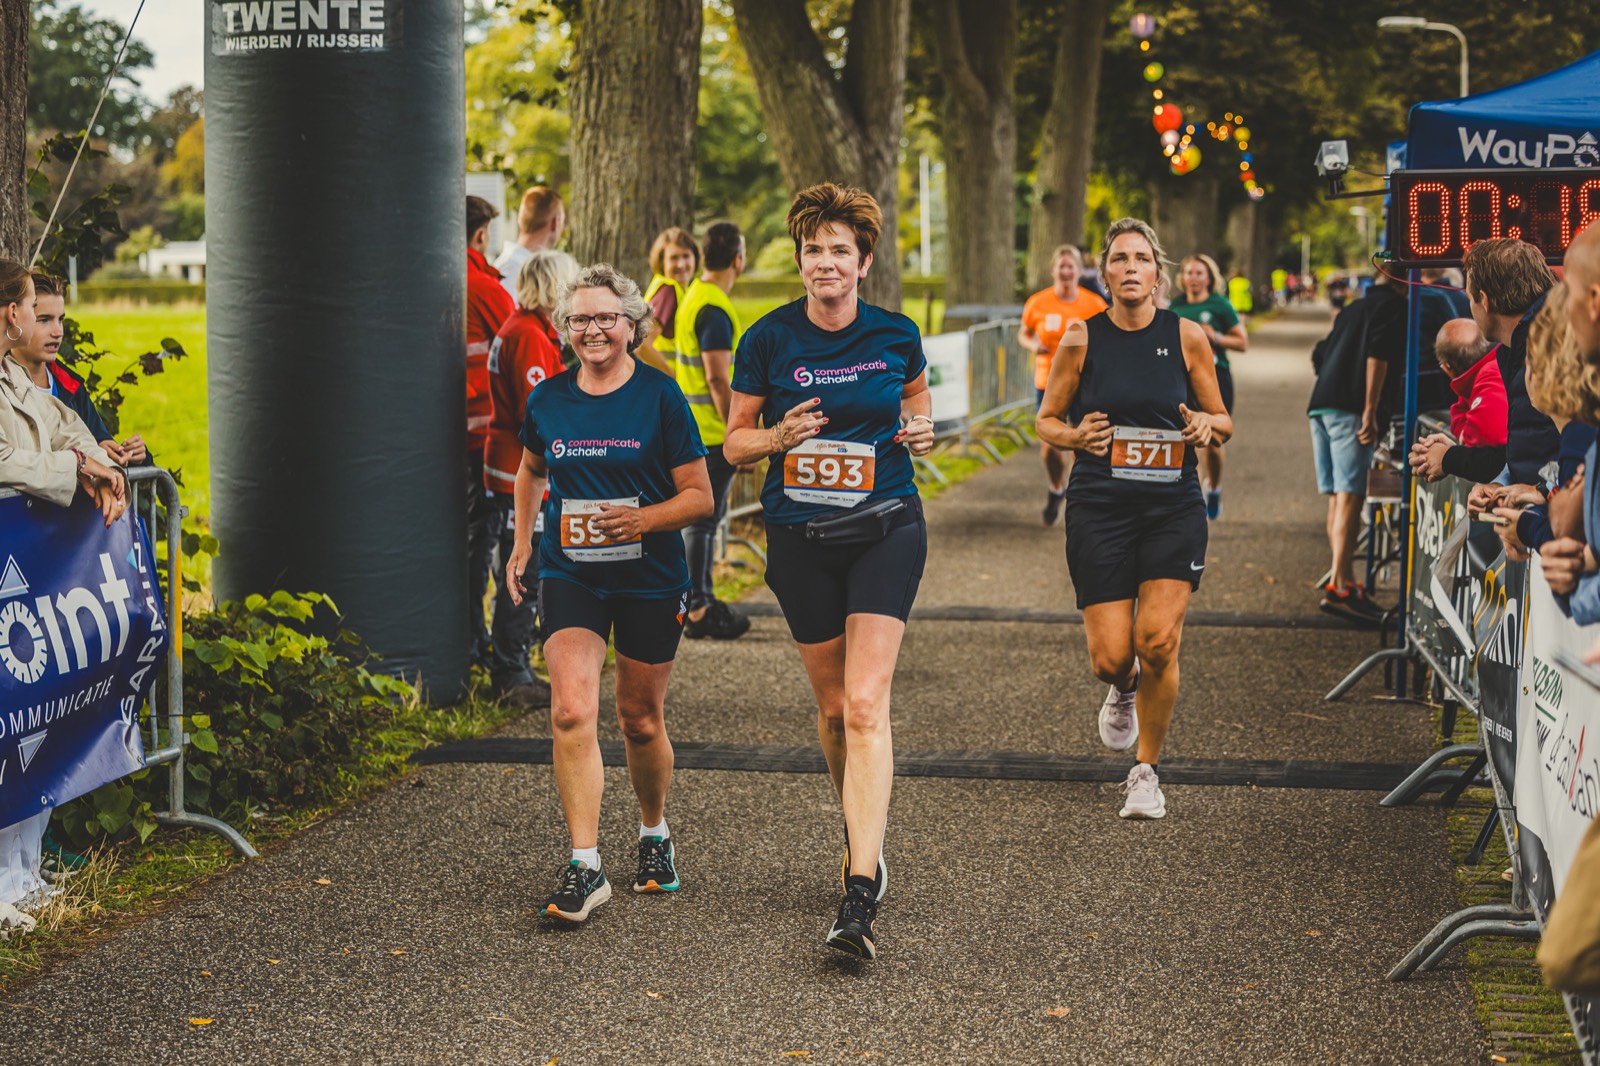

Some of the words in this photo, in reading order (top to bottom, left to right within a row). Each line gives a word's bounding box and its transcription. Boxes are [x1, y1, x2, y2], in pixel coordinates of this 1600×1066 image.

[222, 0, 386, 32] TWENTE
[225, 35, 292, 50] WIERDEN
[296, 34, 302, 48] /
[307, 34, 384, 48] RIJSSEN
[813, 360, 887, 376] communicatie
[815, 373, 858, 385] schakel
[566, 447, 607, 457] schakel
[567, 438, 641, 449] communicatie
[1125, 442, 1172, 466] 571
[797, 457, 864, 488] 593
[569, 517, 607, 545] 59
[120, 542, 165, 726] GARMIN
